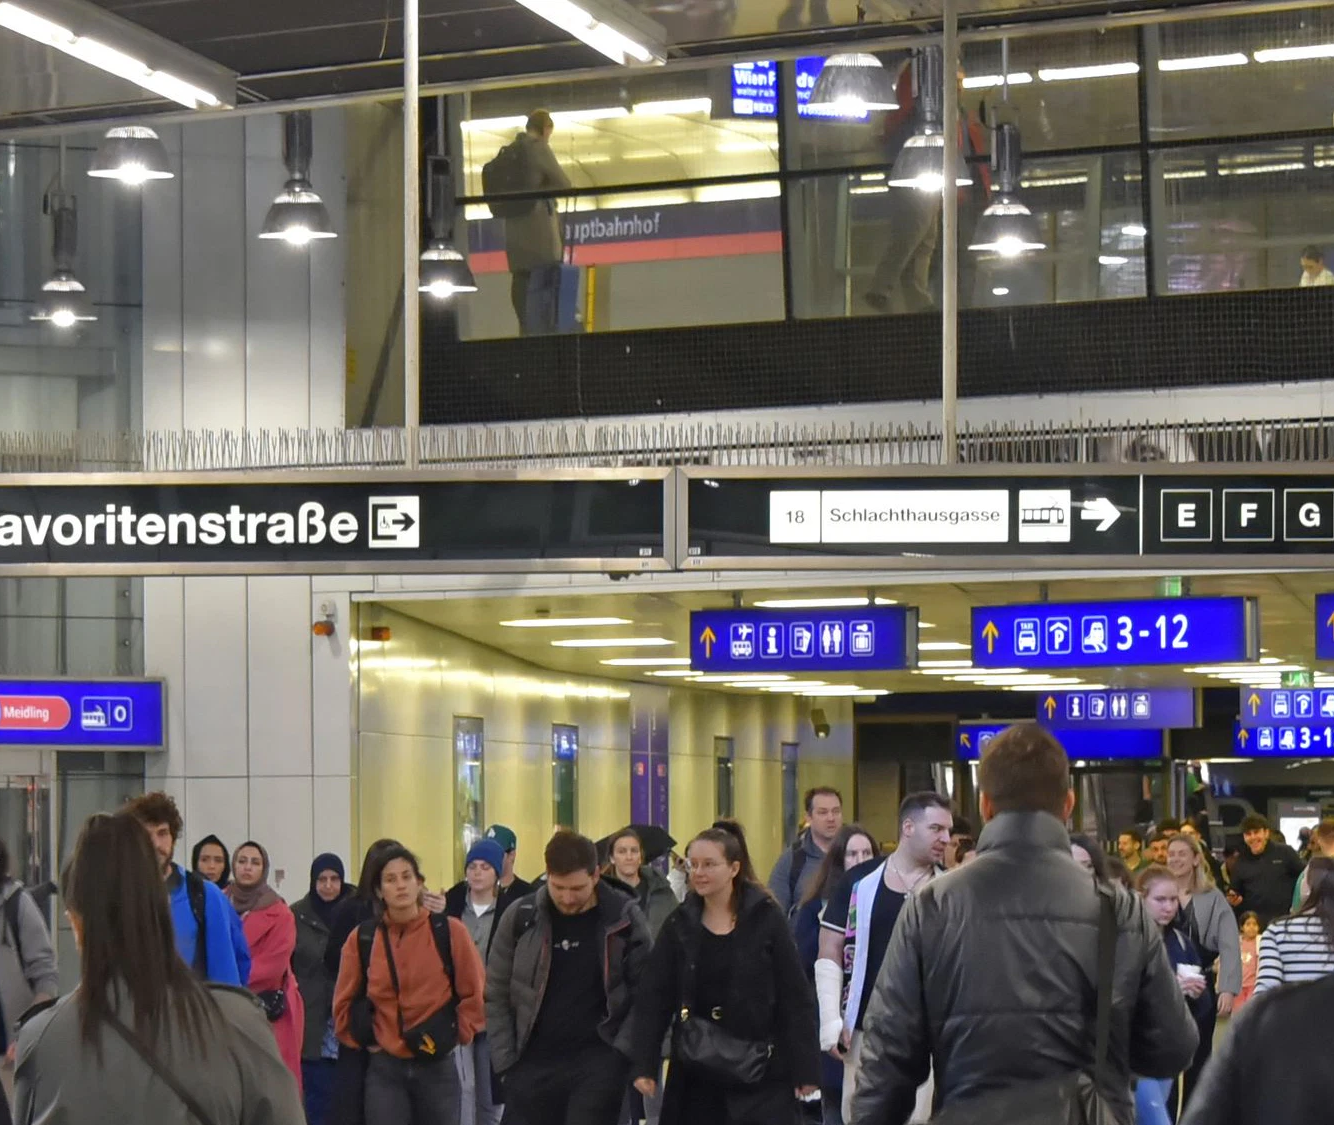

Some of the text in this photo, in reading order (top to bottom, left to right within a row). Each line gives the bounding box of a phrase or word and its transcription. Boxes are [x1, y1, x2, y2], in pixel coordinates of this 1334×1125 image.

[565, 211, 660, 244] auptbahnhof
[786, 508, 1001, 526] 18 Schlachthausgasse
[1177, 503, 1196, 527] E
[1240, 503, 1257, 527] F
[1298, 503, 1321, 527] G
[1117, 614, 1189, 650] 3-12
[3, 706, 49, 722] Meidling
